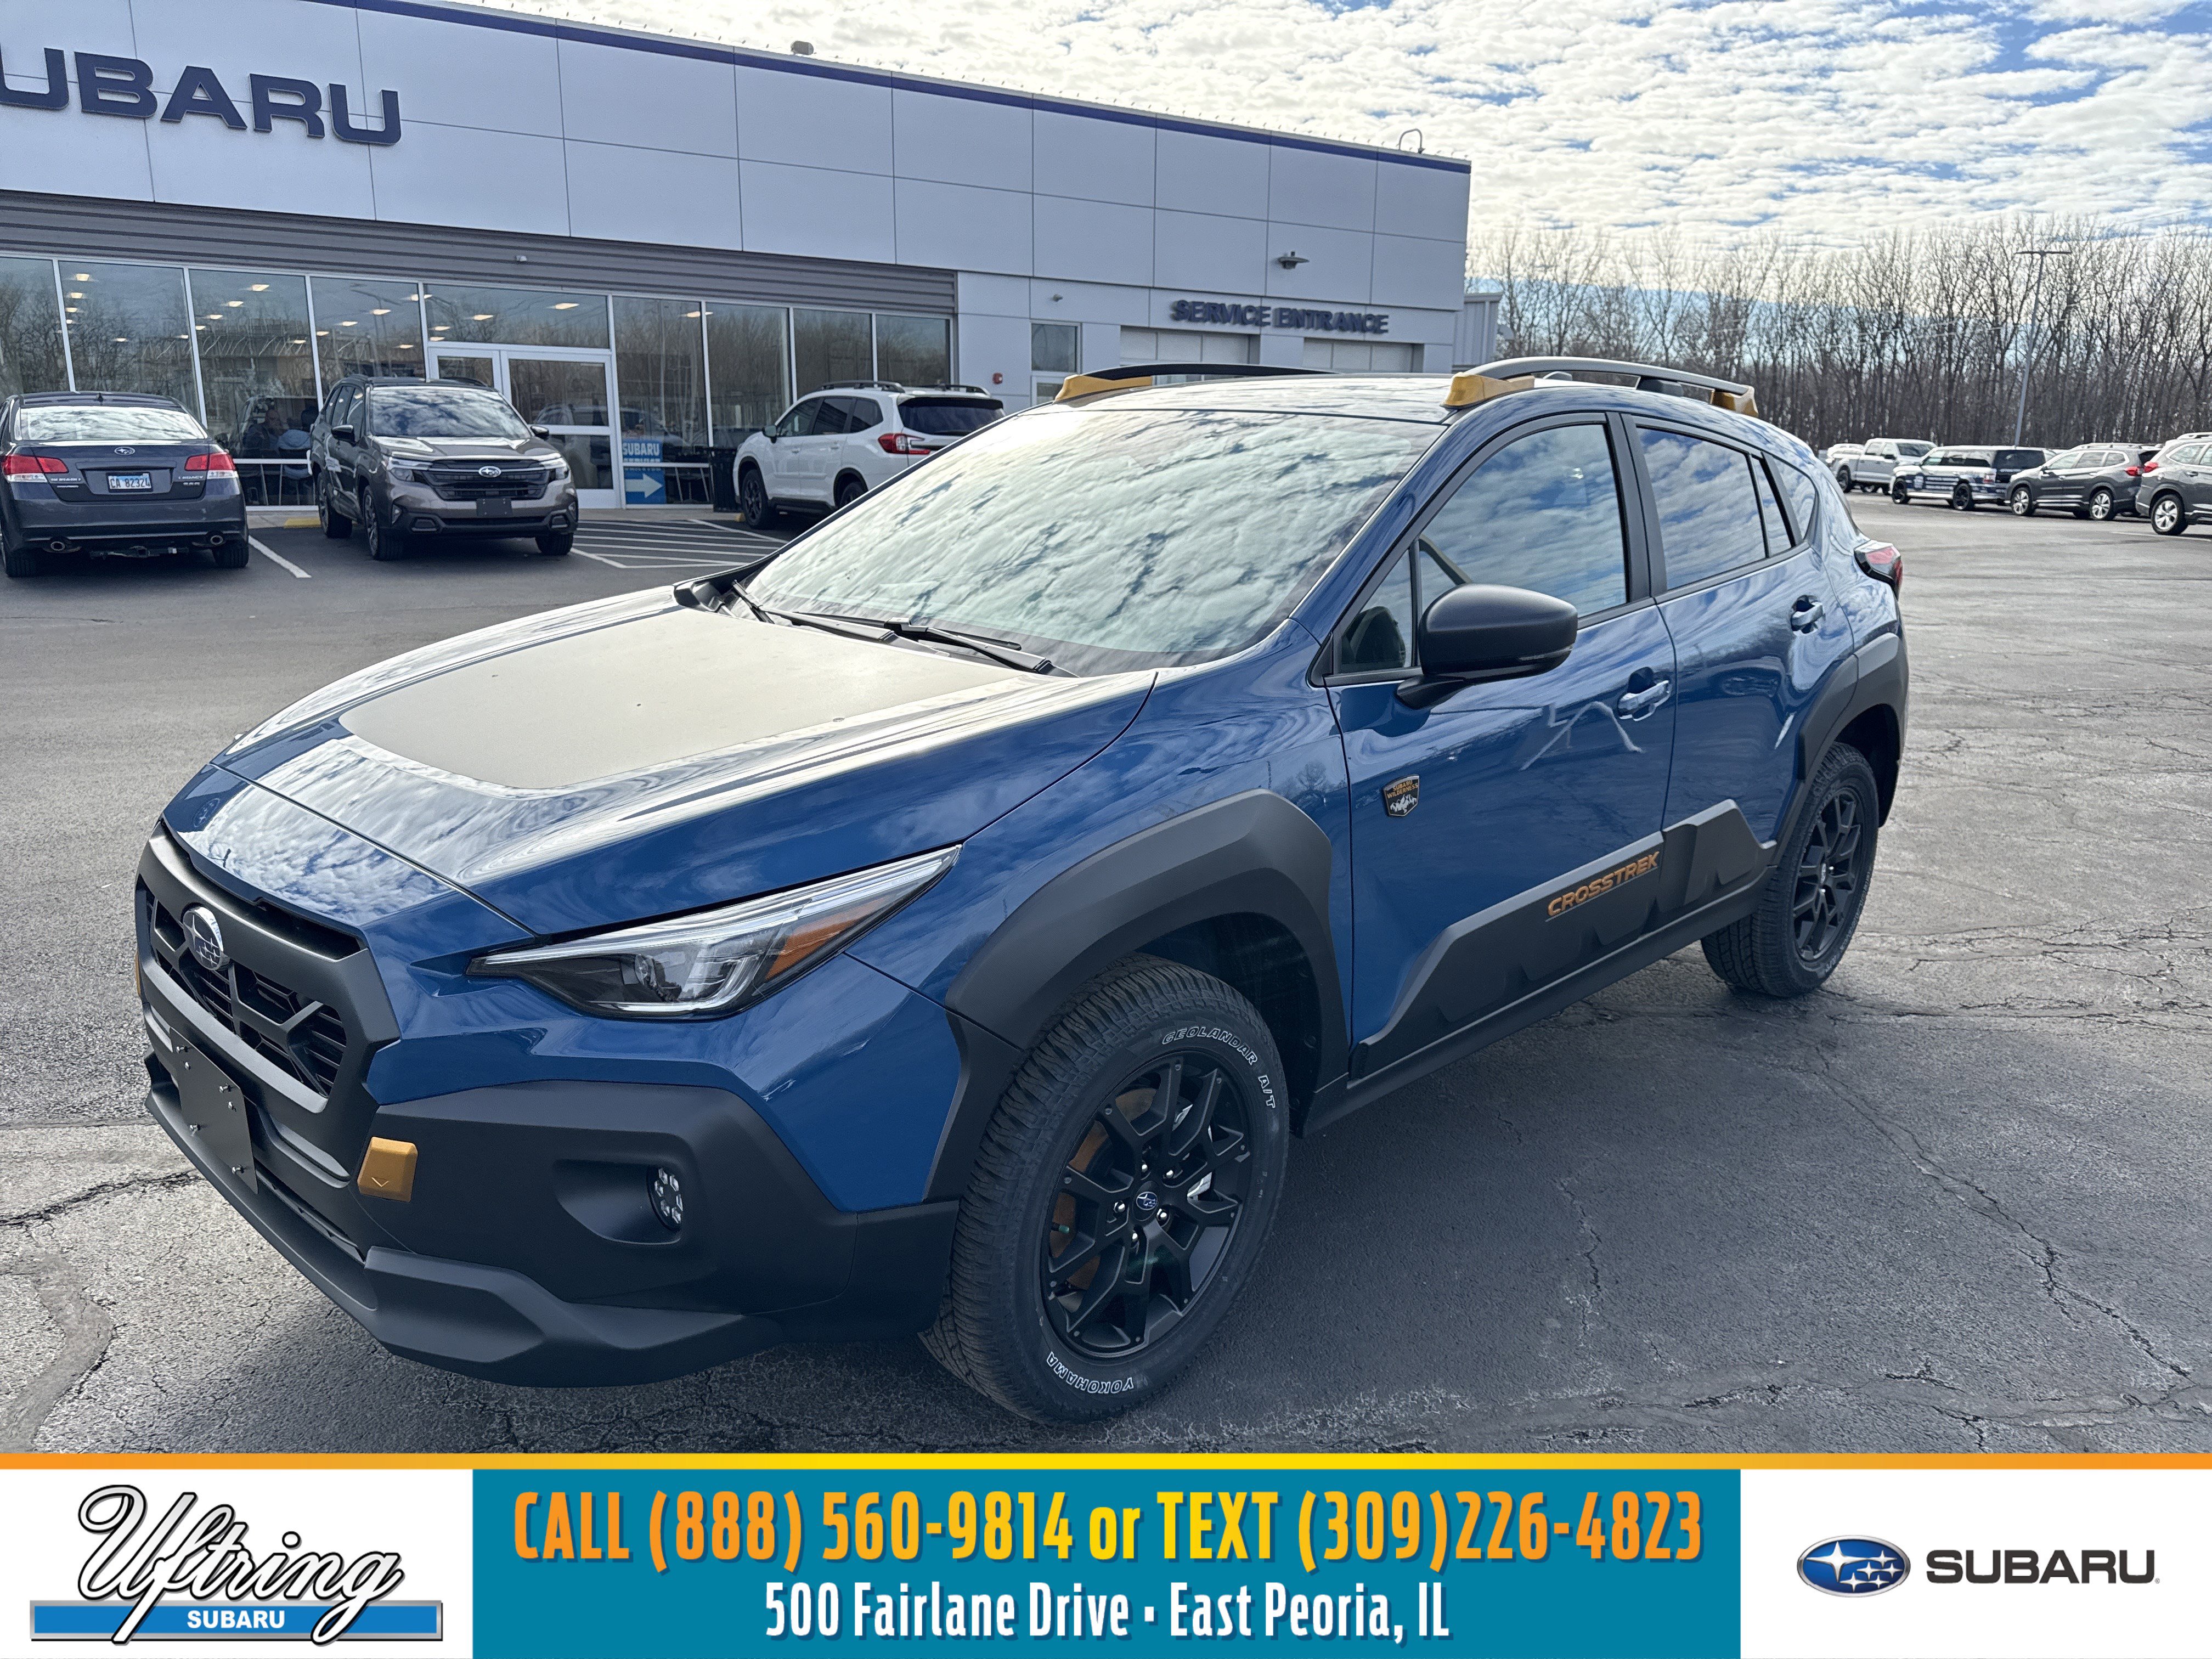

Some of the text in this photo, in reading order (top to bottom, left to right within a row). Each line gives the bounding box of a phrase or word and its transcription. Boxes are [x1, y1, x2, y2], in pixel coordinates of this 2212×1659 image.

[1171, 300, 1389, 334] SERVICE ENTRANCE
[623, 443, 660, 456] SUBARU
[110, 478, 121, 488] CA
[1387, 783, 1418, 798] WILDERNESS
[1393, 780, 1413, 791] SUBARU
[1547, 851, 1660, 917] CROSSTREK
[1161, 1026, 1276, 1109] GEOLANDAR A/T
[1046, 1351, 1134, 1394] YOKOHAMA
